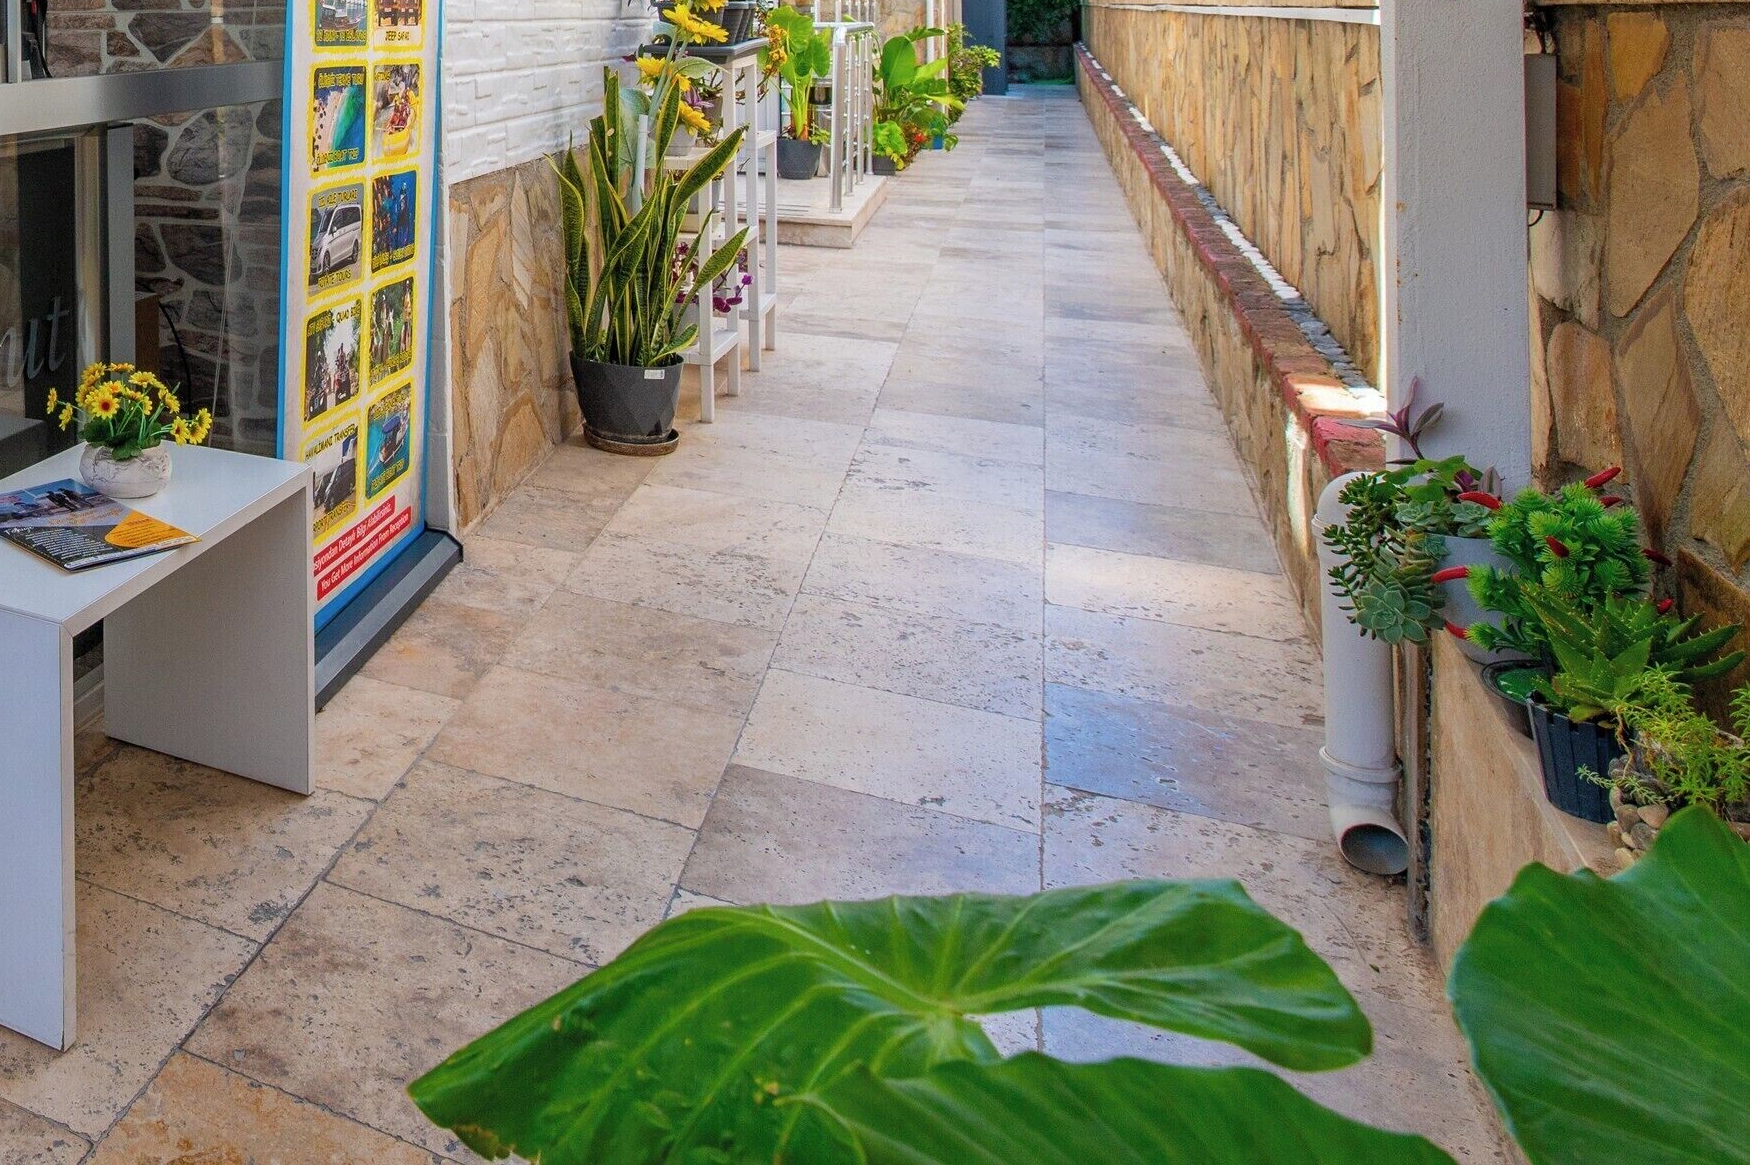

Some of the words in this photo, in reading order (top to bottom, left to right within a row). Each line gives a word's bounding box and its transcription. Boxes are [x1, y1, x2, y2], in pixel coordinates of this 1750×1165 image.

[320, 577, 330, 591] You
[330, 570, 340, 584] Get
[341, 560, 353, 578] More
[353, 541, 379, 569] Information
[378, 532, 389, 548] From
[389, 514, 409, 541] Reception
